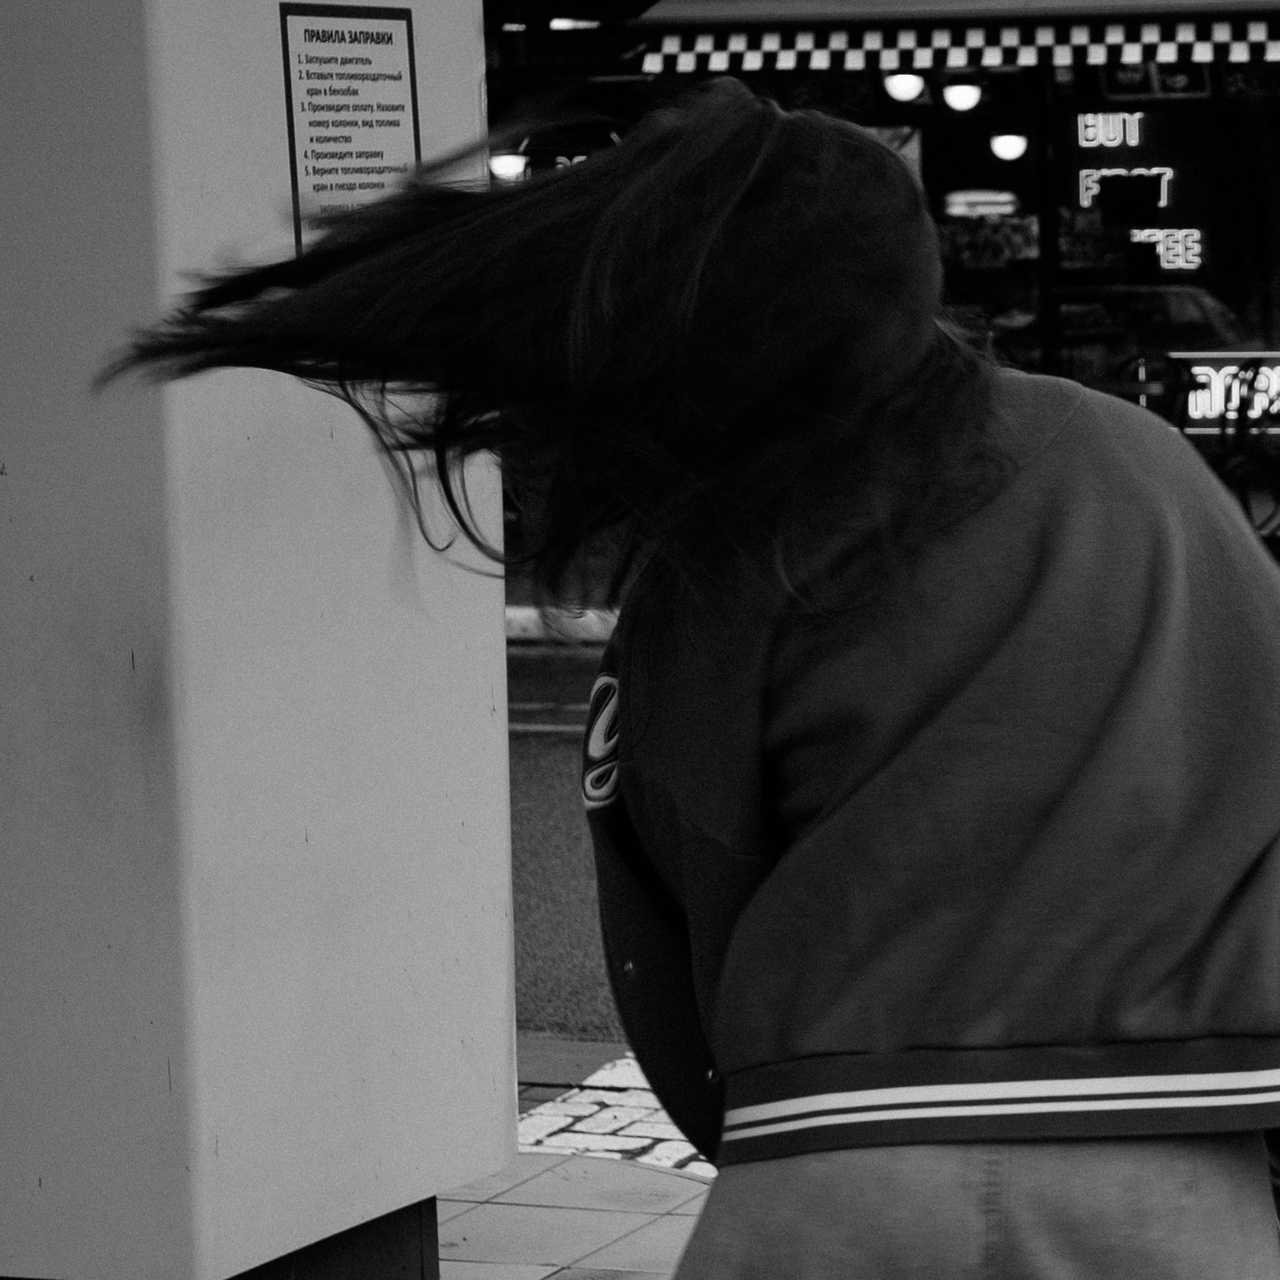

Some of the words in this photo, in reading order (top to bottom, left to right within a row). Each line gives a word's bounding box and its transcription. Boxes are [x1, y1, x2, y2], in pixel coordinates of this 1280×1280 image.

[304, 29, 346, 43] ПРАВИЛА
[348, 30, 393, 45] ЗАПРАВКИ
[305, 54, 338, 66] Заглушите
[340, 56, 372, 66] двигатель
[308, 102, 350, 113] Произведите
[1077, 112, 1145, 147] BUT
[315, 135, 352, 143] количество
[311, 150, 353, 160] Произведите
[312, 165, 339, 176] Верните
